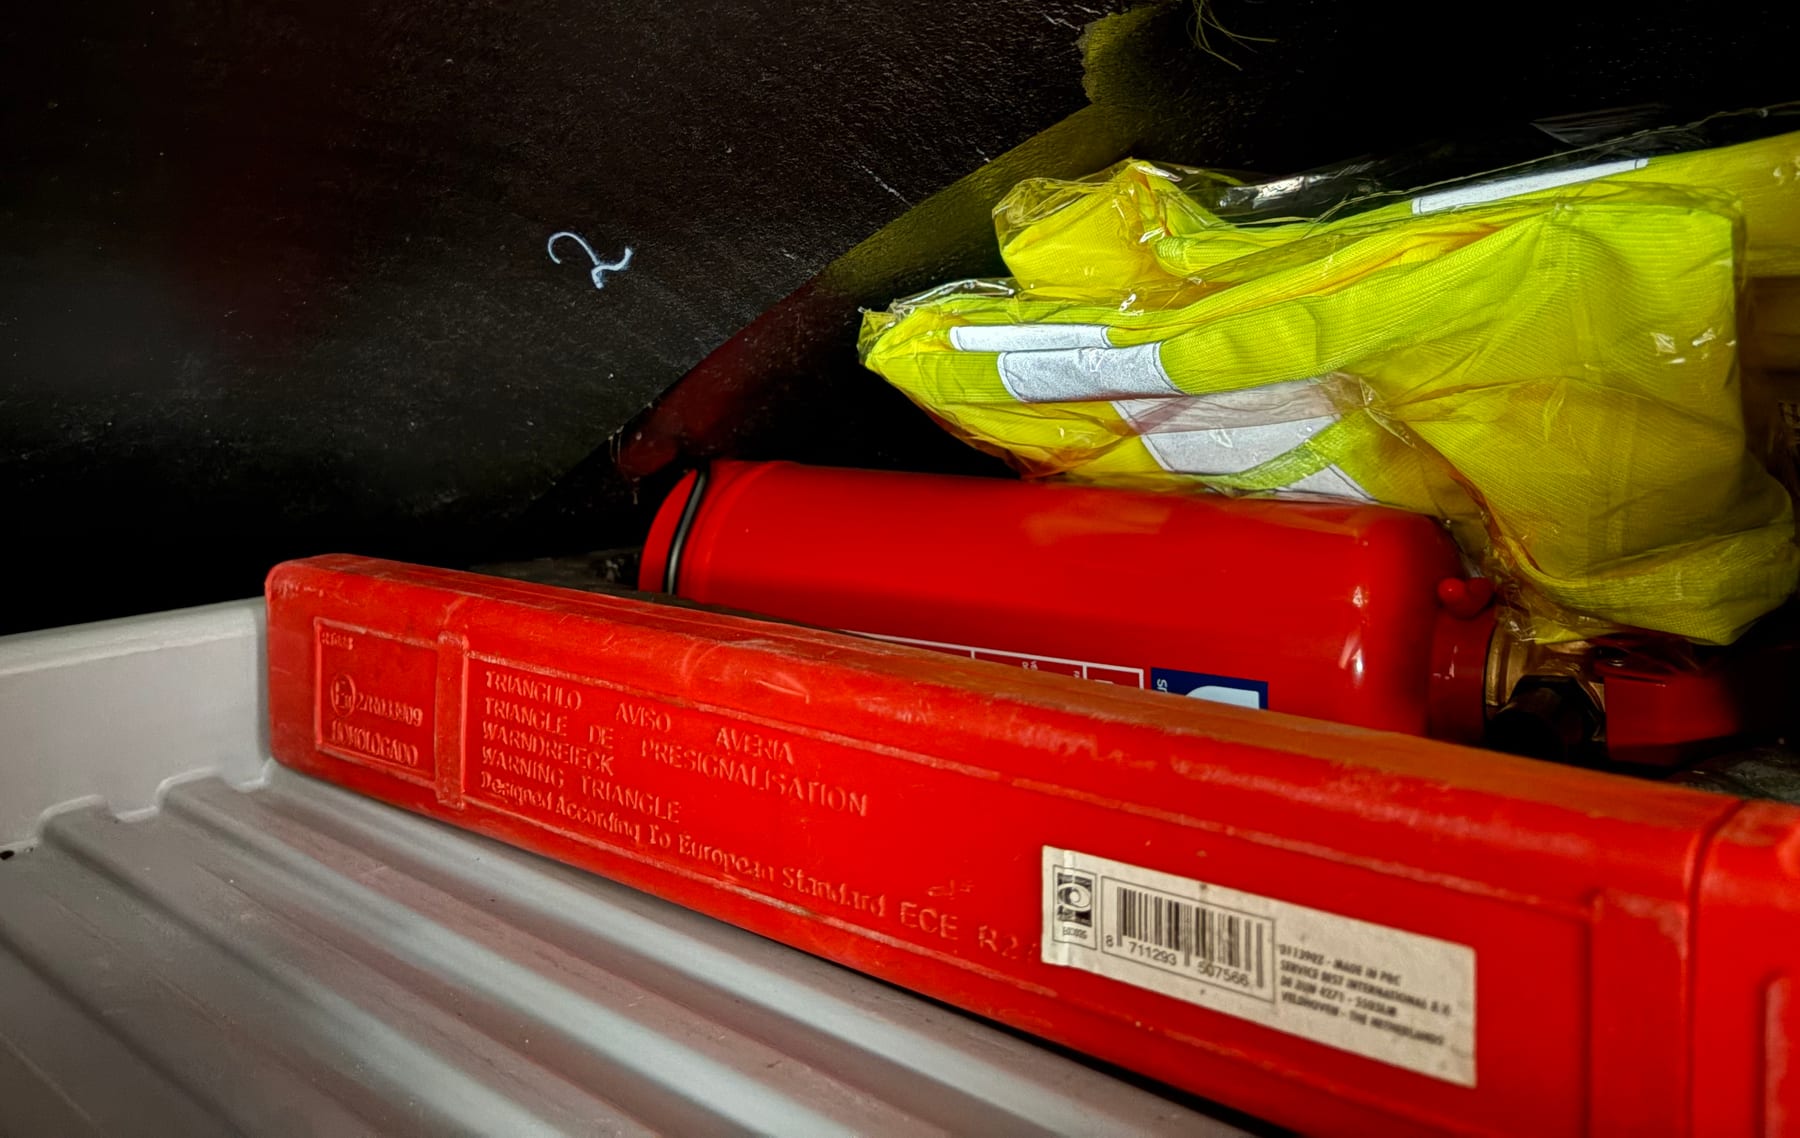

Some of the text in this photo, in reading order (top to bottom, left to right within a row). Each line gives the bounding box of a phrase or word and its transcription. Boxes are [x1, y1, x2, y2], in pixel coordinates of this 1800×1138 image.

[548, 232, 633, 289] 2
[331, 719, 418, 766] HOMOLOGADO
[486, 671, 795, 765] TRIANGULO AVISO AVERIA
[482, 721, 615, 777] WARNDREIECK
[484, 697, 868, 817] TRIANGLE DE PRESIGNALISATION
[481, 746, 680, 824] WARNING TRIANGLE
[480, 771, 552, 812] Designed
[555, 795, 640, 844] According
[649, 823, 671, 849] To
[679, 832, 775, 882] European
[782, 866, 887, 918] Standard
[900, 901, 959, 940] ECE
[1105, 935, 1250, 987] 8 711293 507566
[1280, 960, 1319, 980] SERVICE
[1346, 978, 1428, 1010] INTERNATIONAL
[1333, 958, 1363, 976] MADE
[1365, 967, 1378, 980] IN
